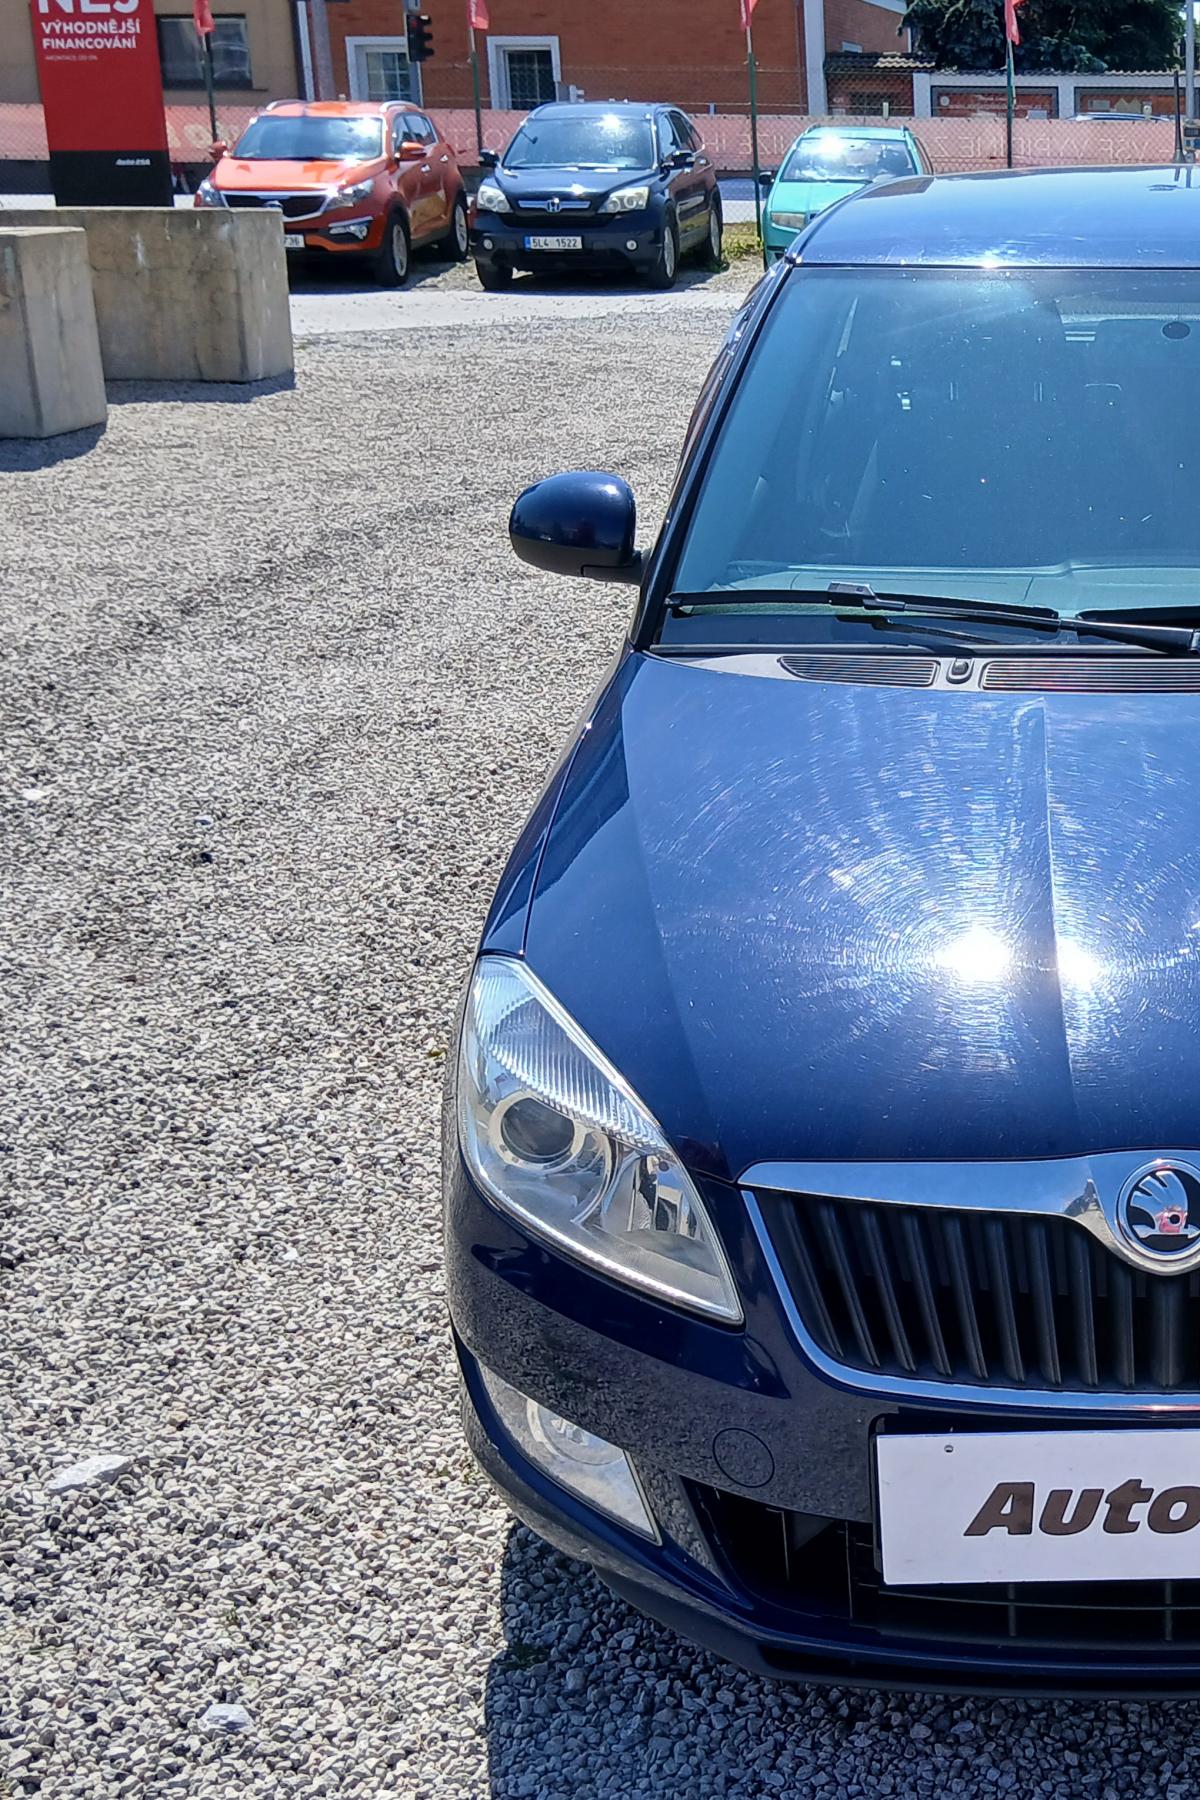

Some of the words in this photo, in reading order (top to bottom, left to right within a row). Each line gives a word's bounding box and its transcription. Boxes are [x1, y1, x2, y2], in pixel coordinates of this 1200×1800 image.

[41, 18, 141, 35] VÝHODNĚJŠÍ
[42, 35, 137, 49] FINANCOVÁNÍ
[532, 238, 549, 248] 5L4
[556, 238, 578, 248] 1522
